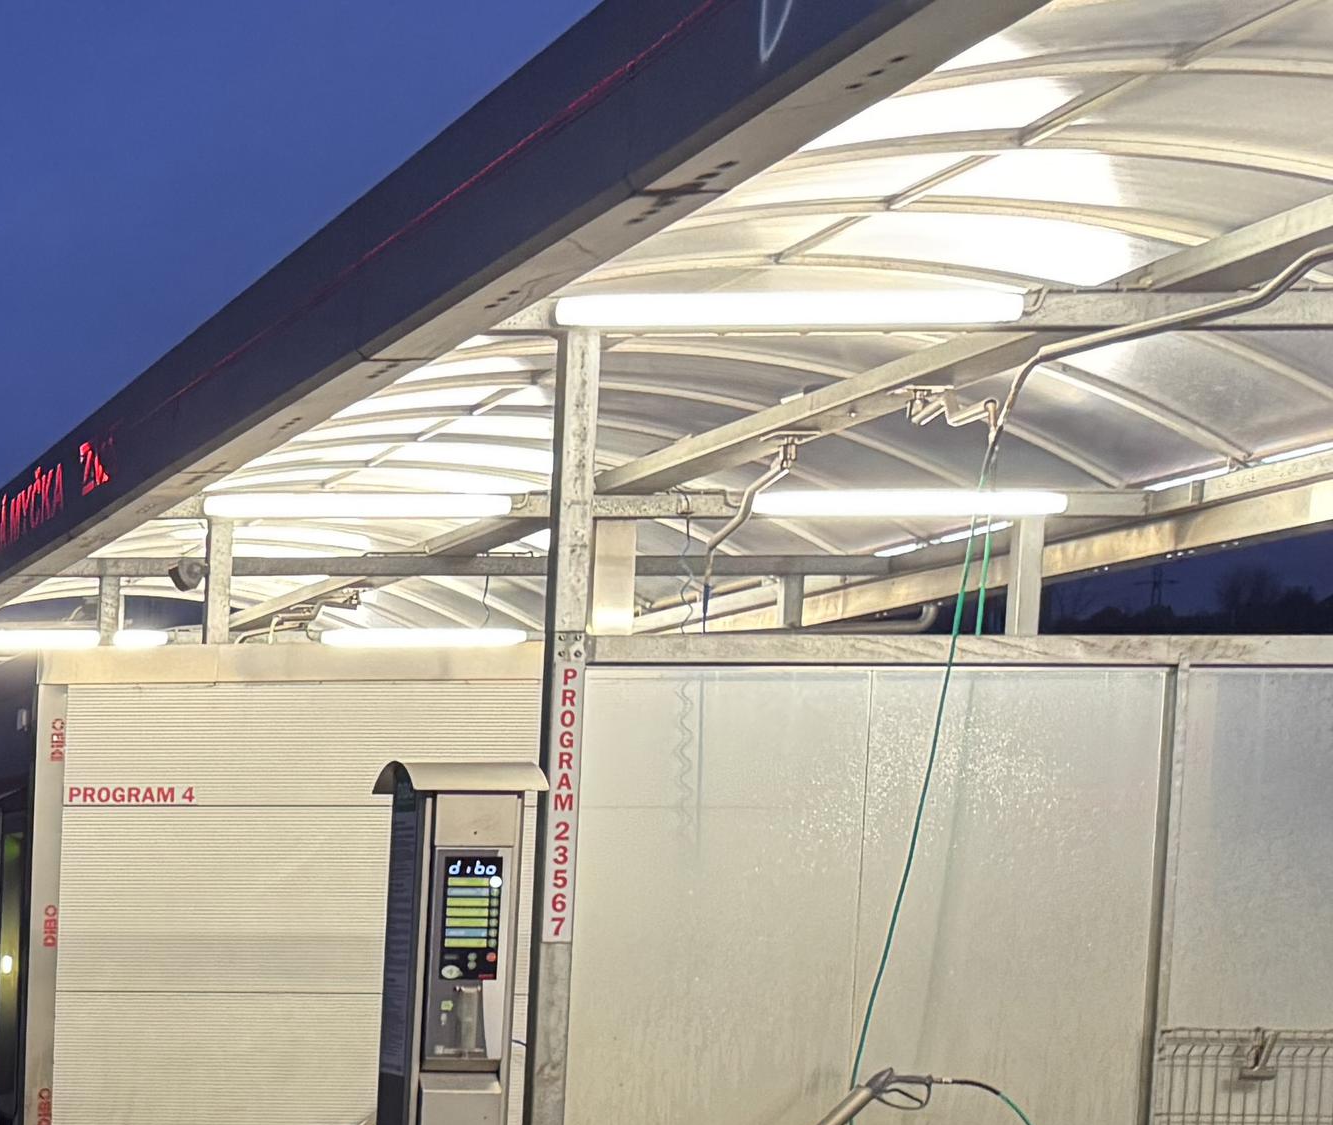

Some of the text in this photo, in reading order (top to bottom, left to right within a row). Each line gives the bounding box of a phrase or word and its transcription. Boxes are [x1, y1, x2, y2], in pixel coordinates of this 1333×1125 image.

[10, 464, 64, 541] MYČKA
[68, 786, 195, 803] PROGRAM 4
[550, 668, 578, 937] PROGRAM 23567
[448, 860, 498, 875] dibo
